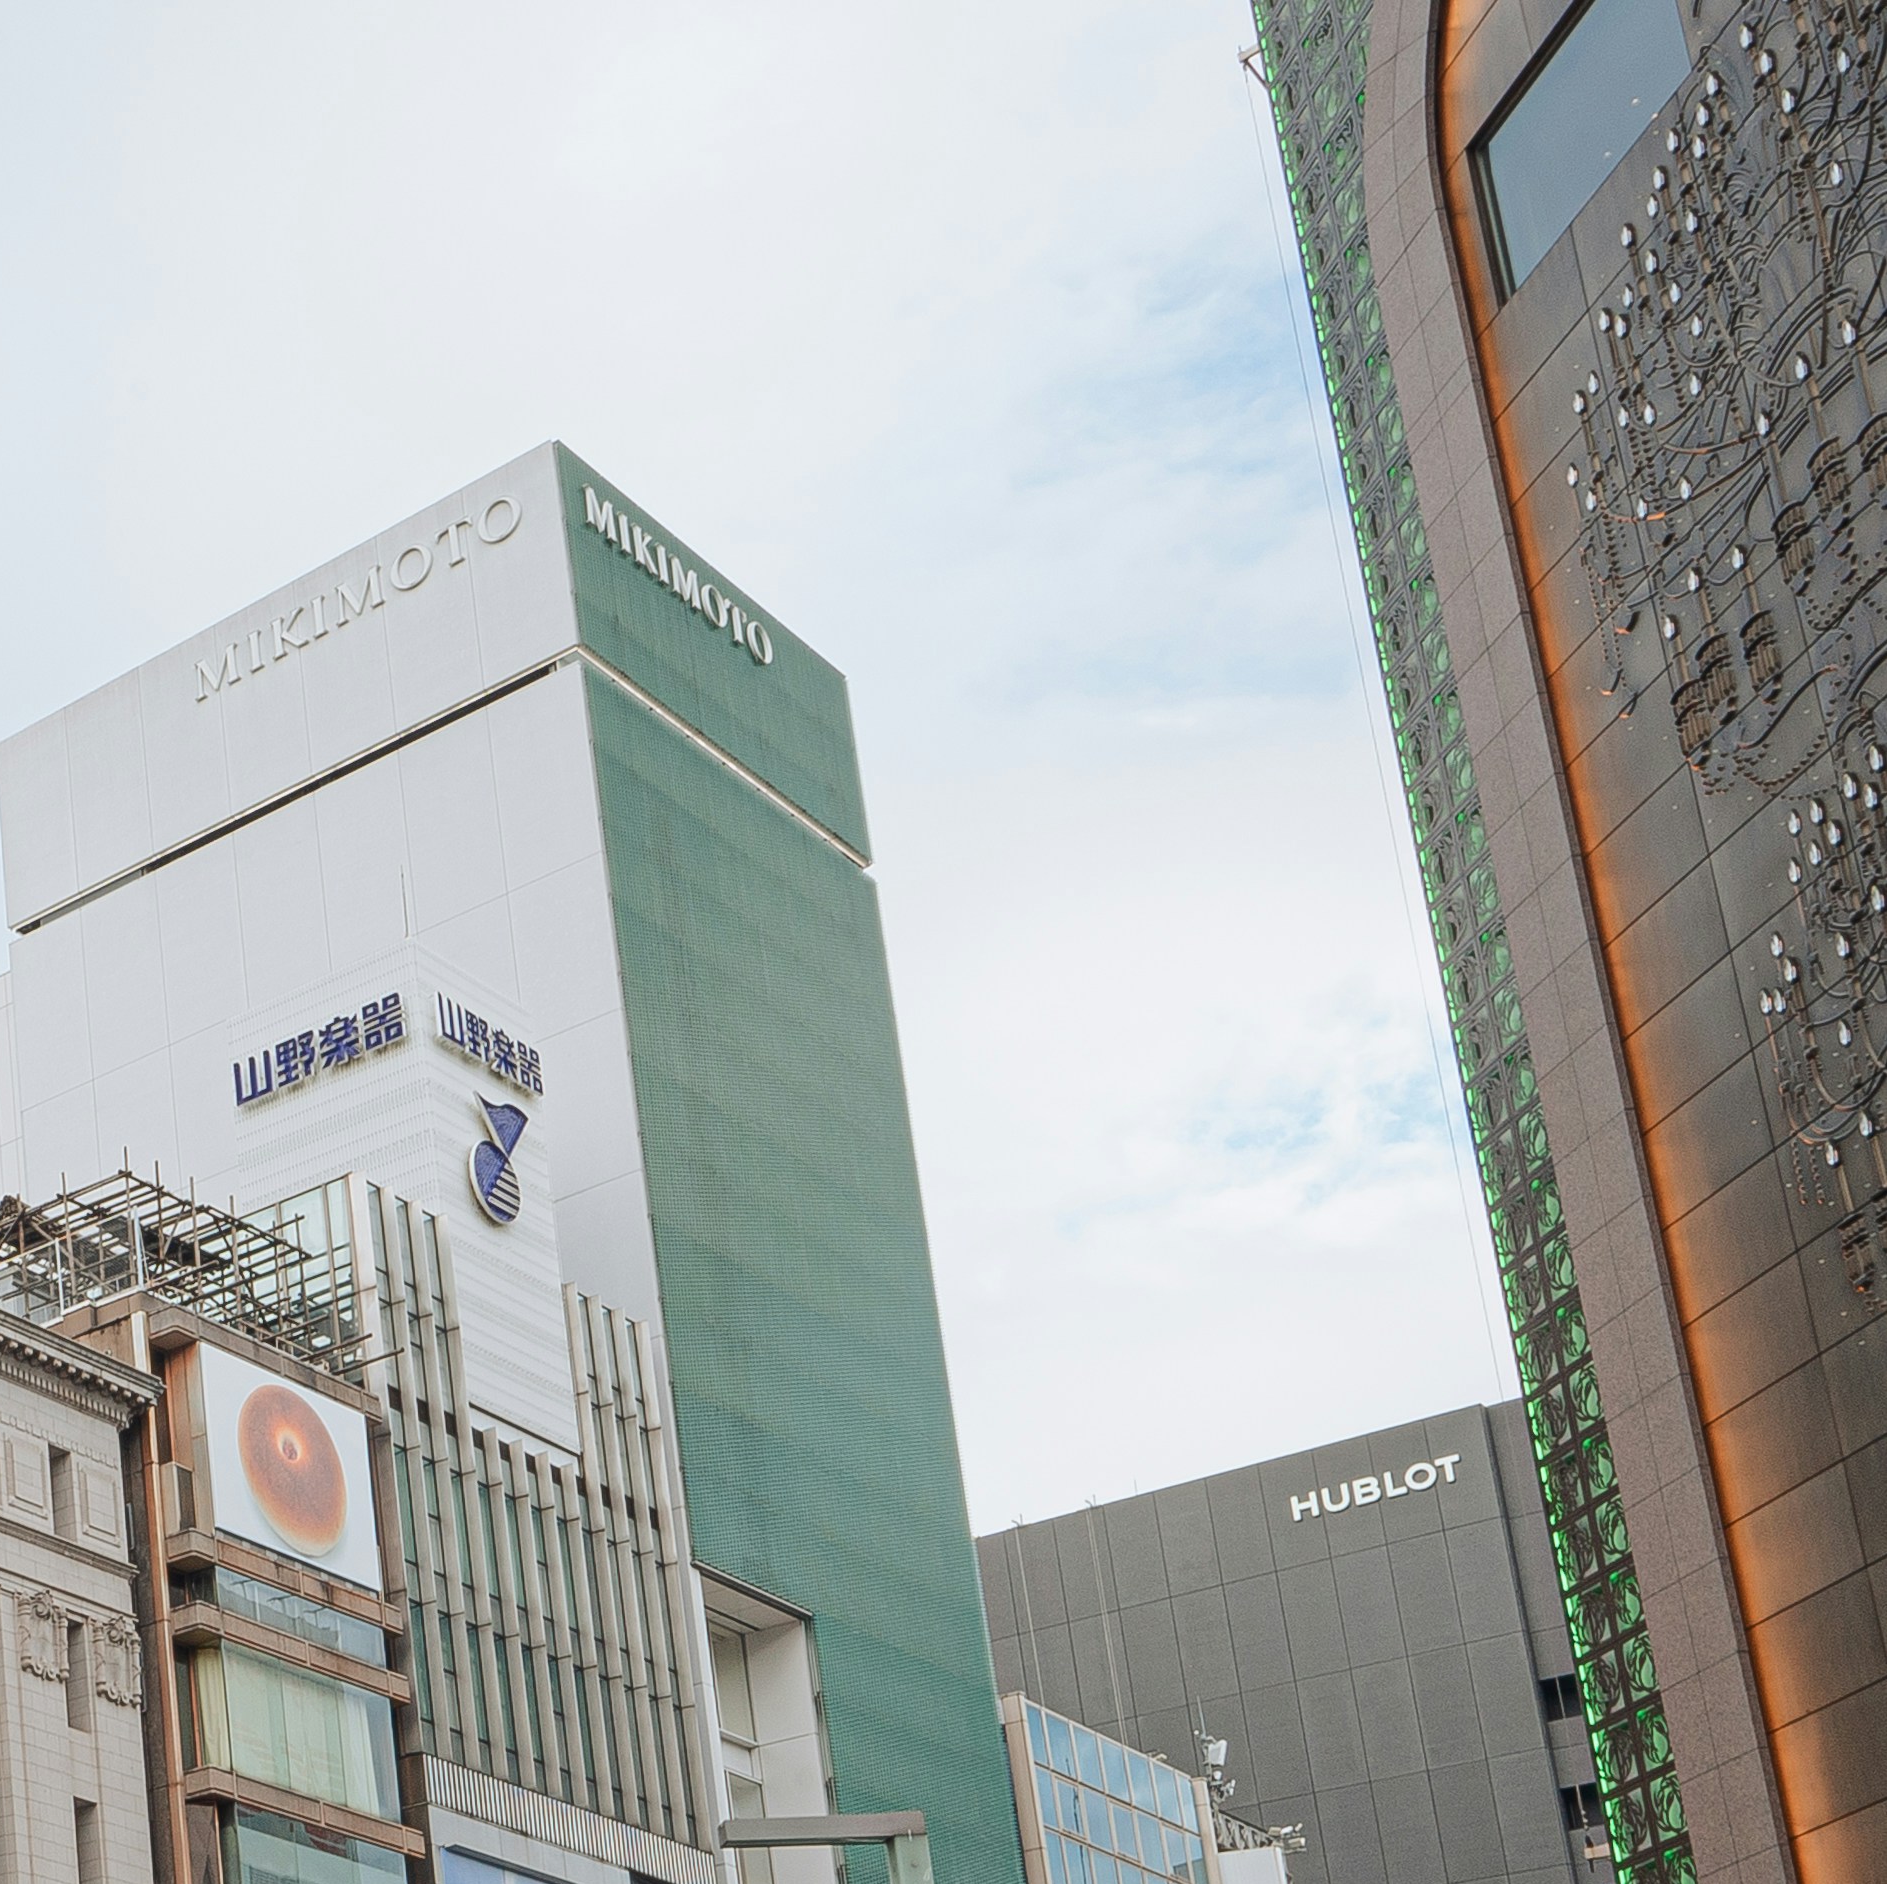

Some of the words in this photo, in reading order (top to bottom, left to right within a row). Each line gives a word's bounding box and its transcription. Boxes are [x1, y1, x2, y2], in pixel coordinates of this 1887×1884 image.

[193, 494, 523, 704] MIKIMOTO
[584, 484, 775, 668] MIKIMOTO
[232, 990, 406, 1108] 山野楽器
[434, 990, 544, 1096] 山野楽器
[1289, 1453, 1463, 1523] HUBLOT
